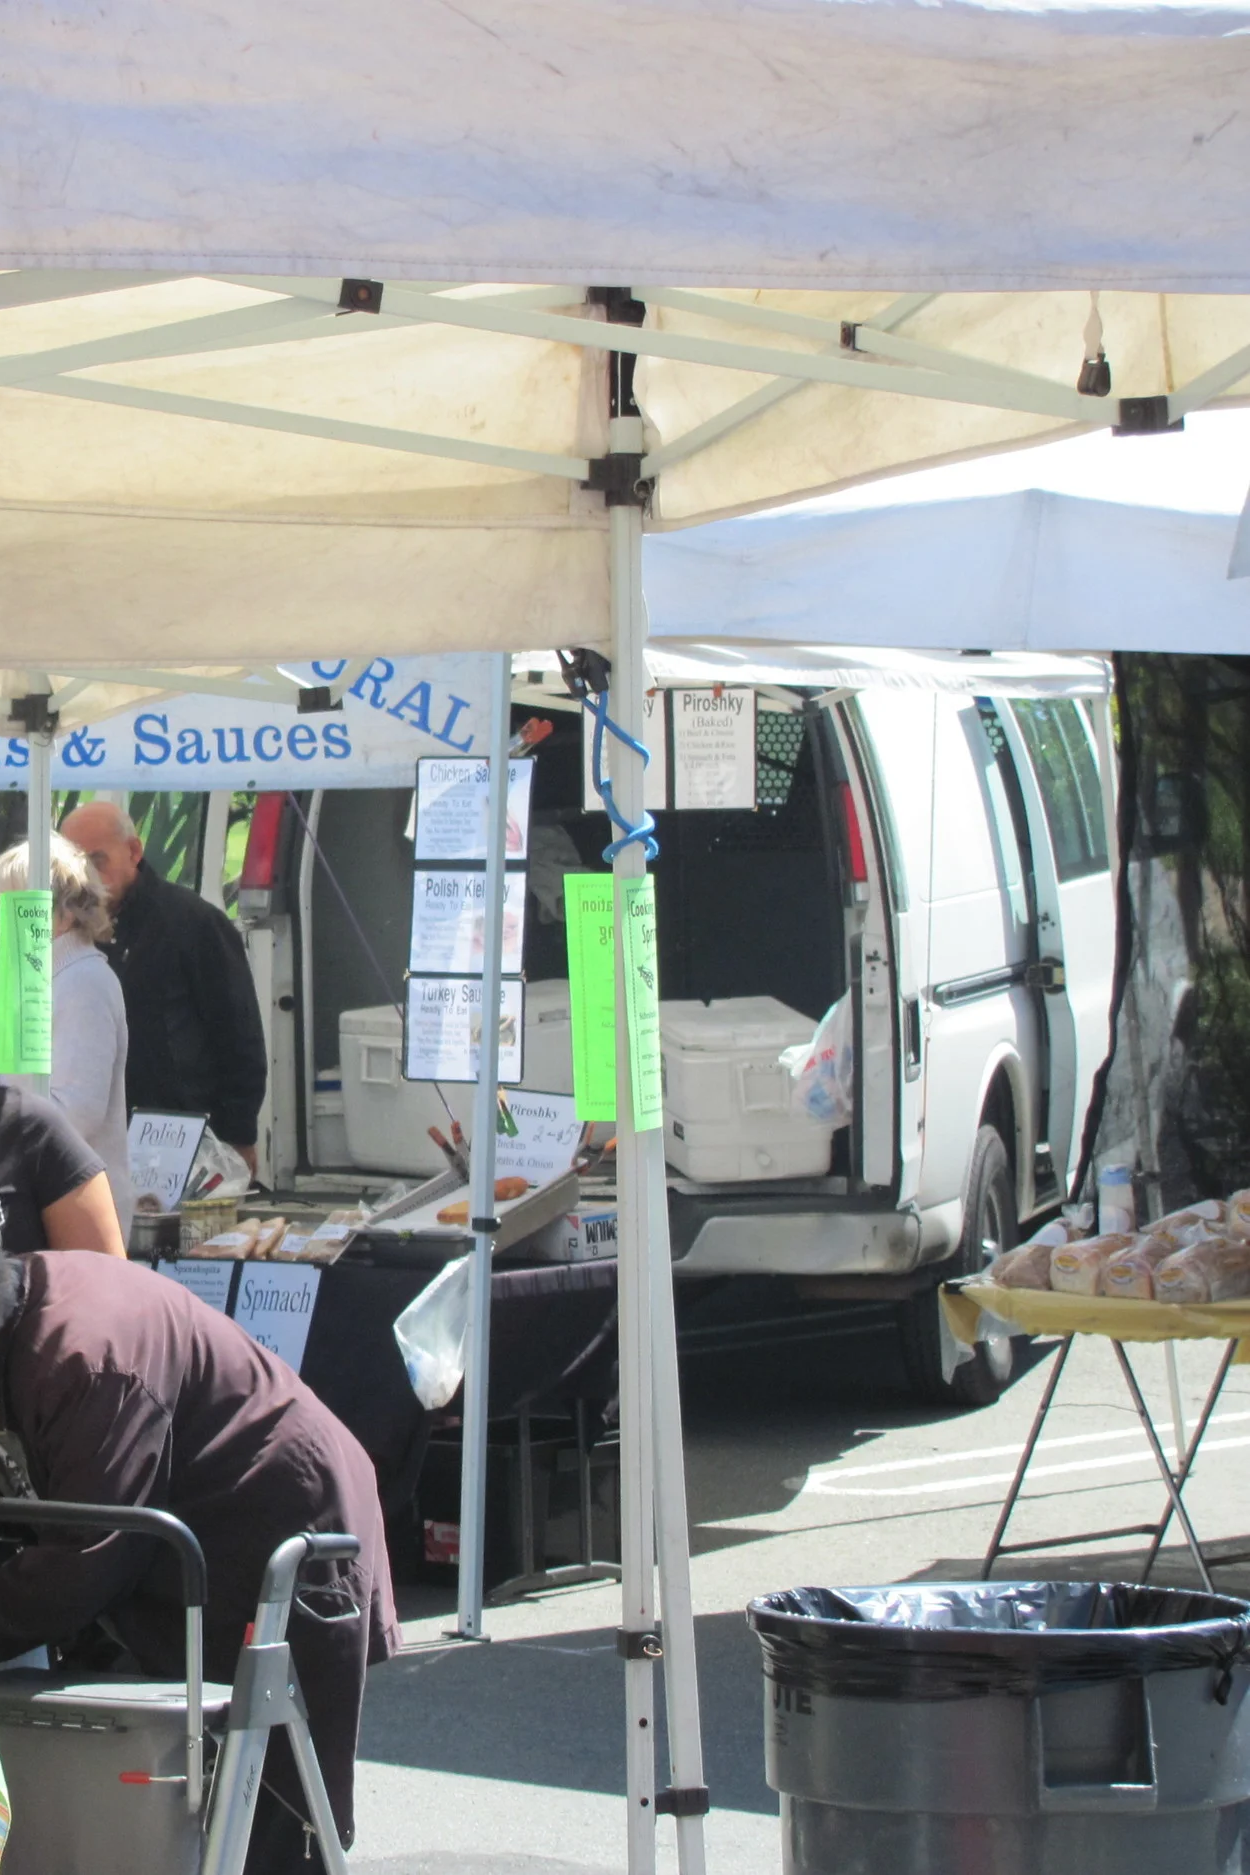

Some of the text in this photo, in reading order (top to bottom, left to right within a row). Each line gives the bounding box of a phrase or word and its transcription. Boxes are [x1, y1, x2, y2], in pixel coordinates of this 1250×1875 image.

[682, 692, 744, 716] Piroshky
[61, 725, 106, 768] &
[133, 713, 352, 766] Sauces
[430, 763, 471, 783] Chicken
[425, 878, 511, 904] Polish Kiely
[421, 981, 457, 1007] Turkey
[420, 1004, 441, 1016] Ready
[511, 1103, 559, 1122] Piroshky
[496, 1138, 527, 1151] hicken
[527, 1157, 554, 1170] Onion
[241, 1279, 311, 1321] Spinach
